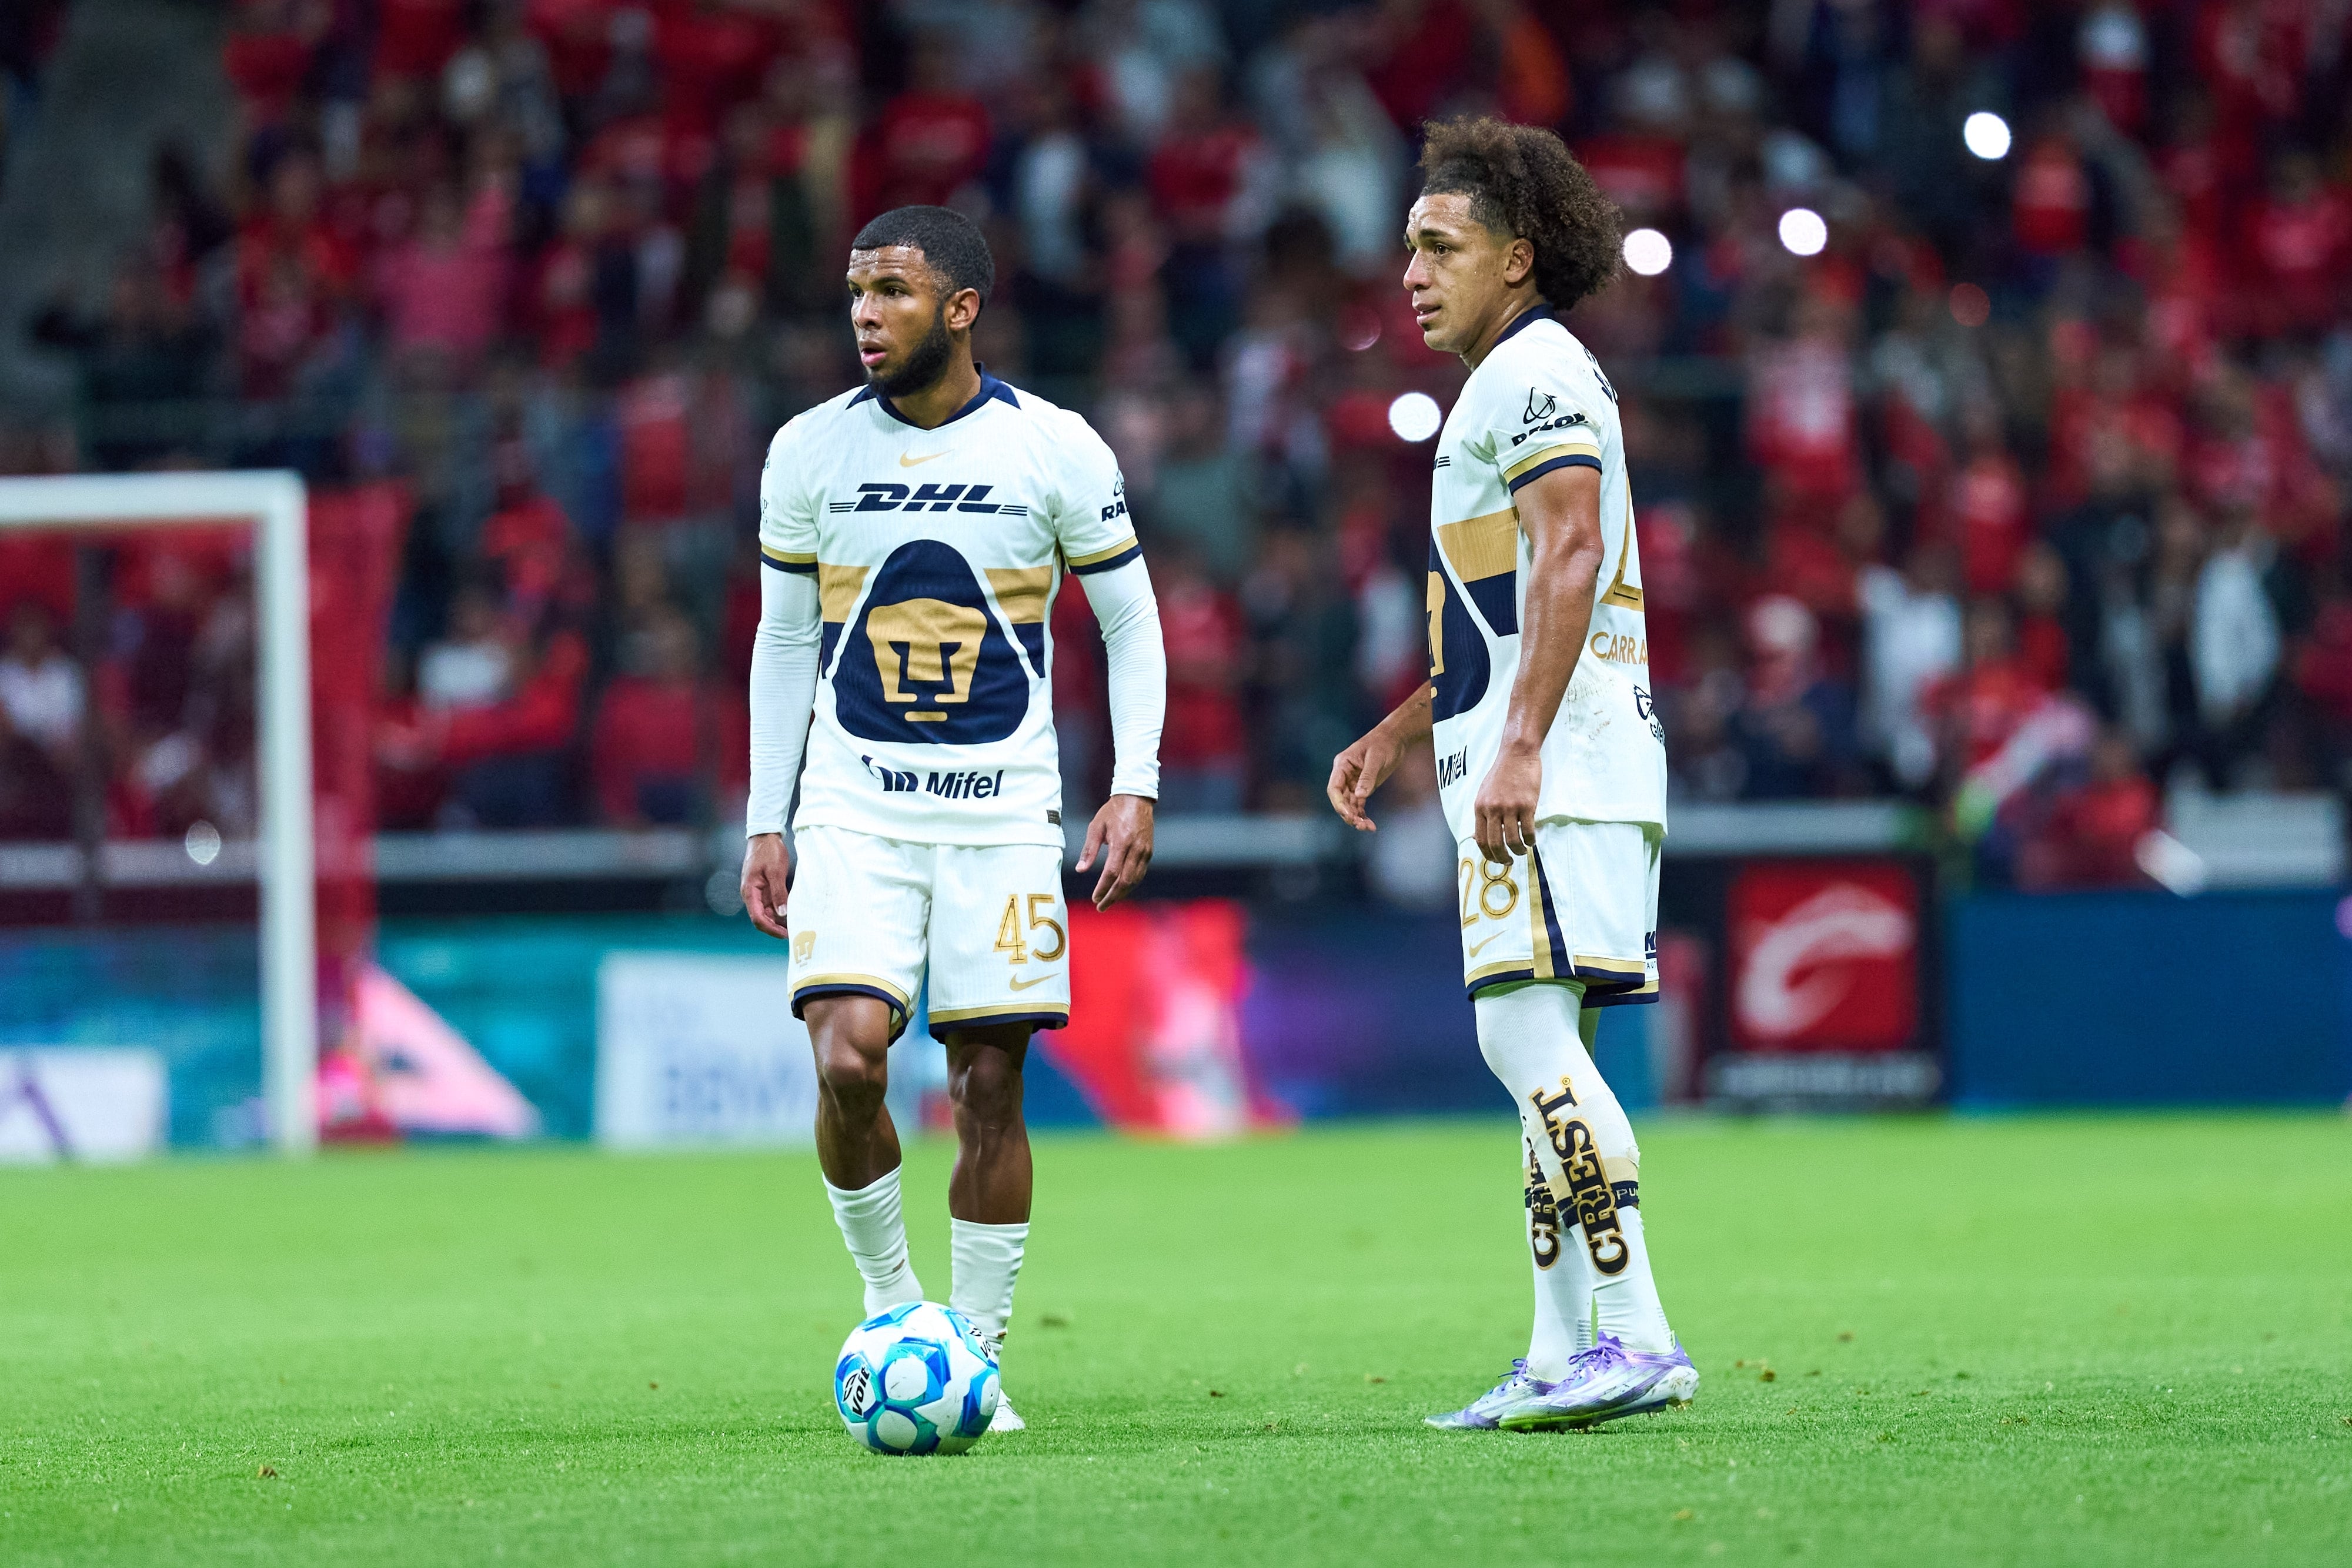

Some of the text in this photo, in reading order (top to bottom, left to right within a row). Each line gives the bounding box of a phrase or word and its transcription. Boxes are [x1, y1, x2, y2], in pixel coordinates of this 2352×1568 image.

[854, 483, 1001, 513] DHL
[926, 770, 1004, 799] Mifel
[1459, 857, 1519, 930] 28
[993, 893, 1066, 964] 45
[1529, 1085, 1630, 1276] CREST
[1616, 1188, 1637, 1200] PU
[853, 1367, 870, 1416] Voit
